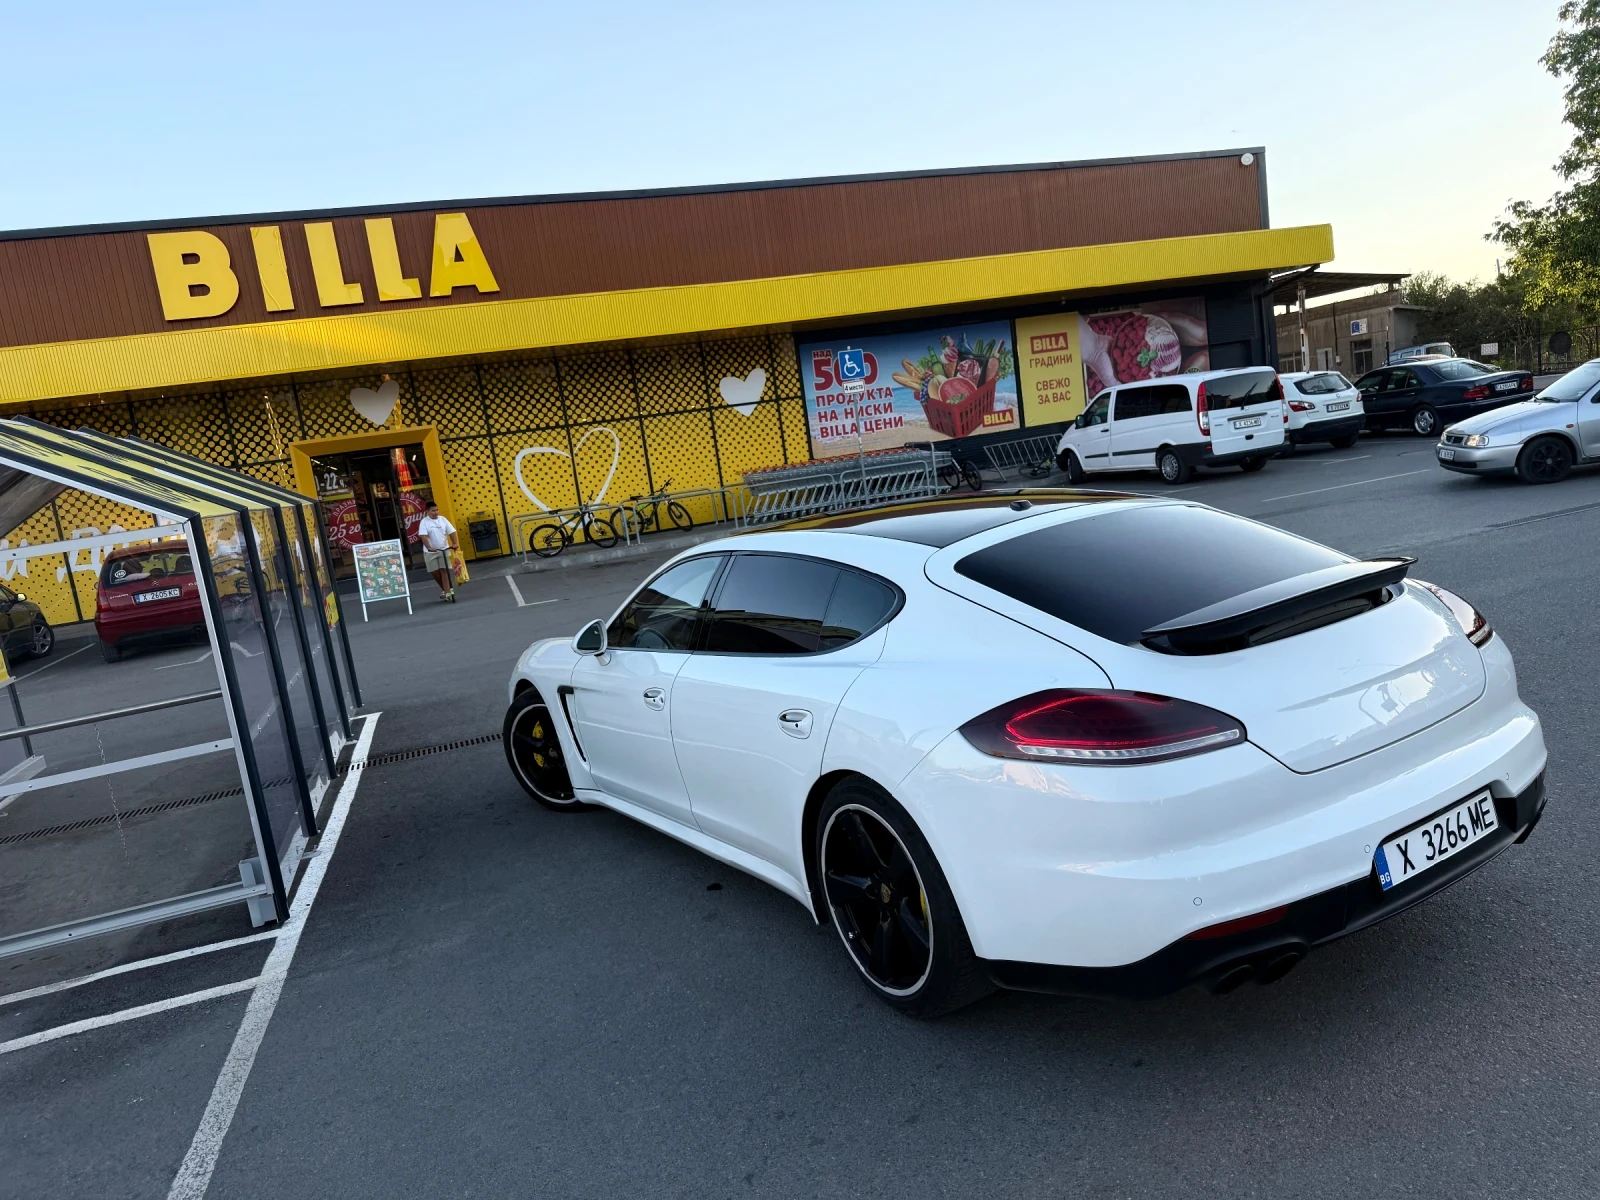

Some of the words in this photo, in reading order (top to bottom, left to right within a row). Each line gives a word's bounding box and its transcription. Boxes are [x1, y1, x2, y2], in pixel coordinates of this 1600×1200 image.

[147, 212, 501, 321] BILLA
[1032, 335, 1067, 351] BILLA
[1030, 354, 1073, 368] ГРАДИНИ
[1036, 377, 1071, 391] СВЕЖО
[816, 387, 893, 407] ПРОДУКТА
[1037, 393, 1051, 405] ЗА
[1052, 391, 1071, 403] ВАС
[818, 411, 839, 423] НА
[844, 402, 893, 419] НИСКИ
[983, 411, 1013, 426] BILLA
[820, 422, 858, 438] BILLA
[864, 416, 904, 433] ЦЕНИ
[329, 523, 347, 541] 25
[150, 589, 168, 600] 2605
[168, 588, 179, 596] KC
[1396, 839, 1416, 875] X
[1421, 810, 1469, 861] 3266
[1467, 796, 1494, 836] ME
[1380, 872, 1391, 885] BG
